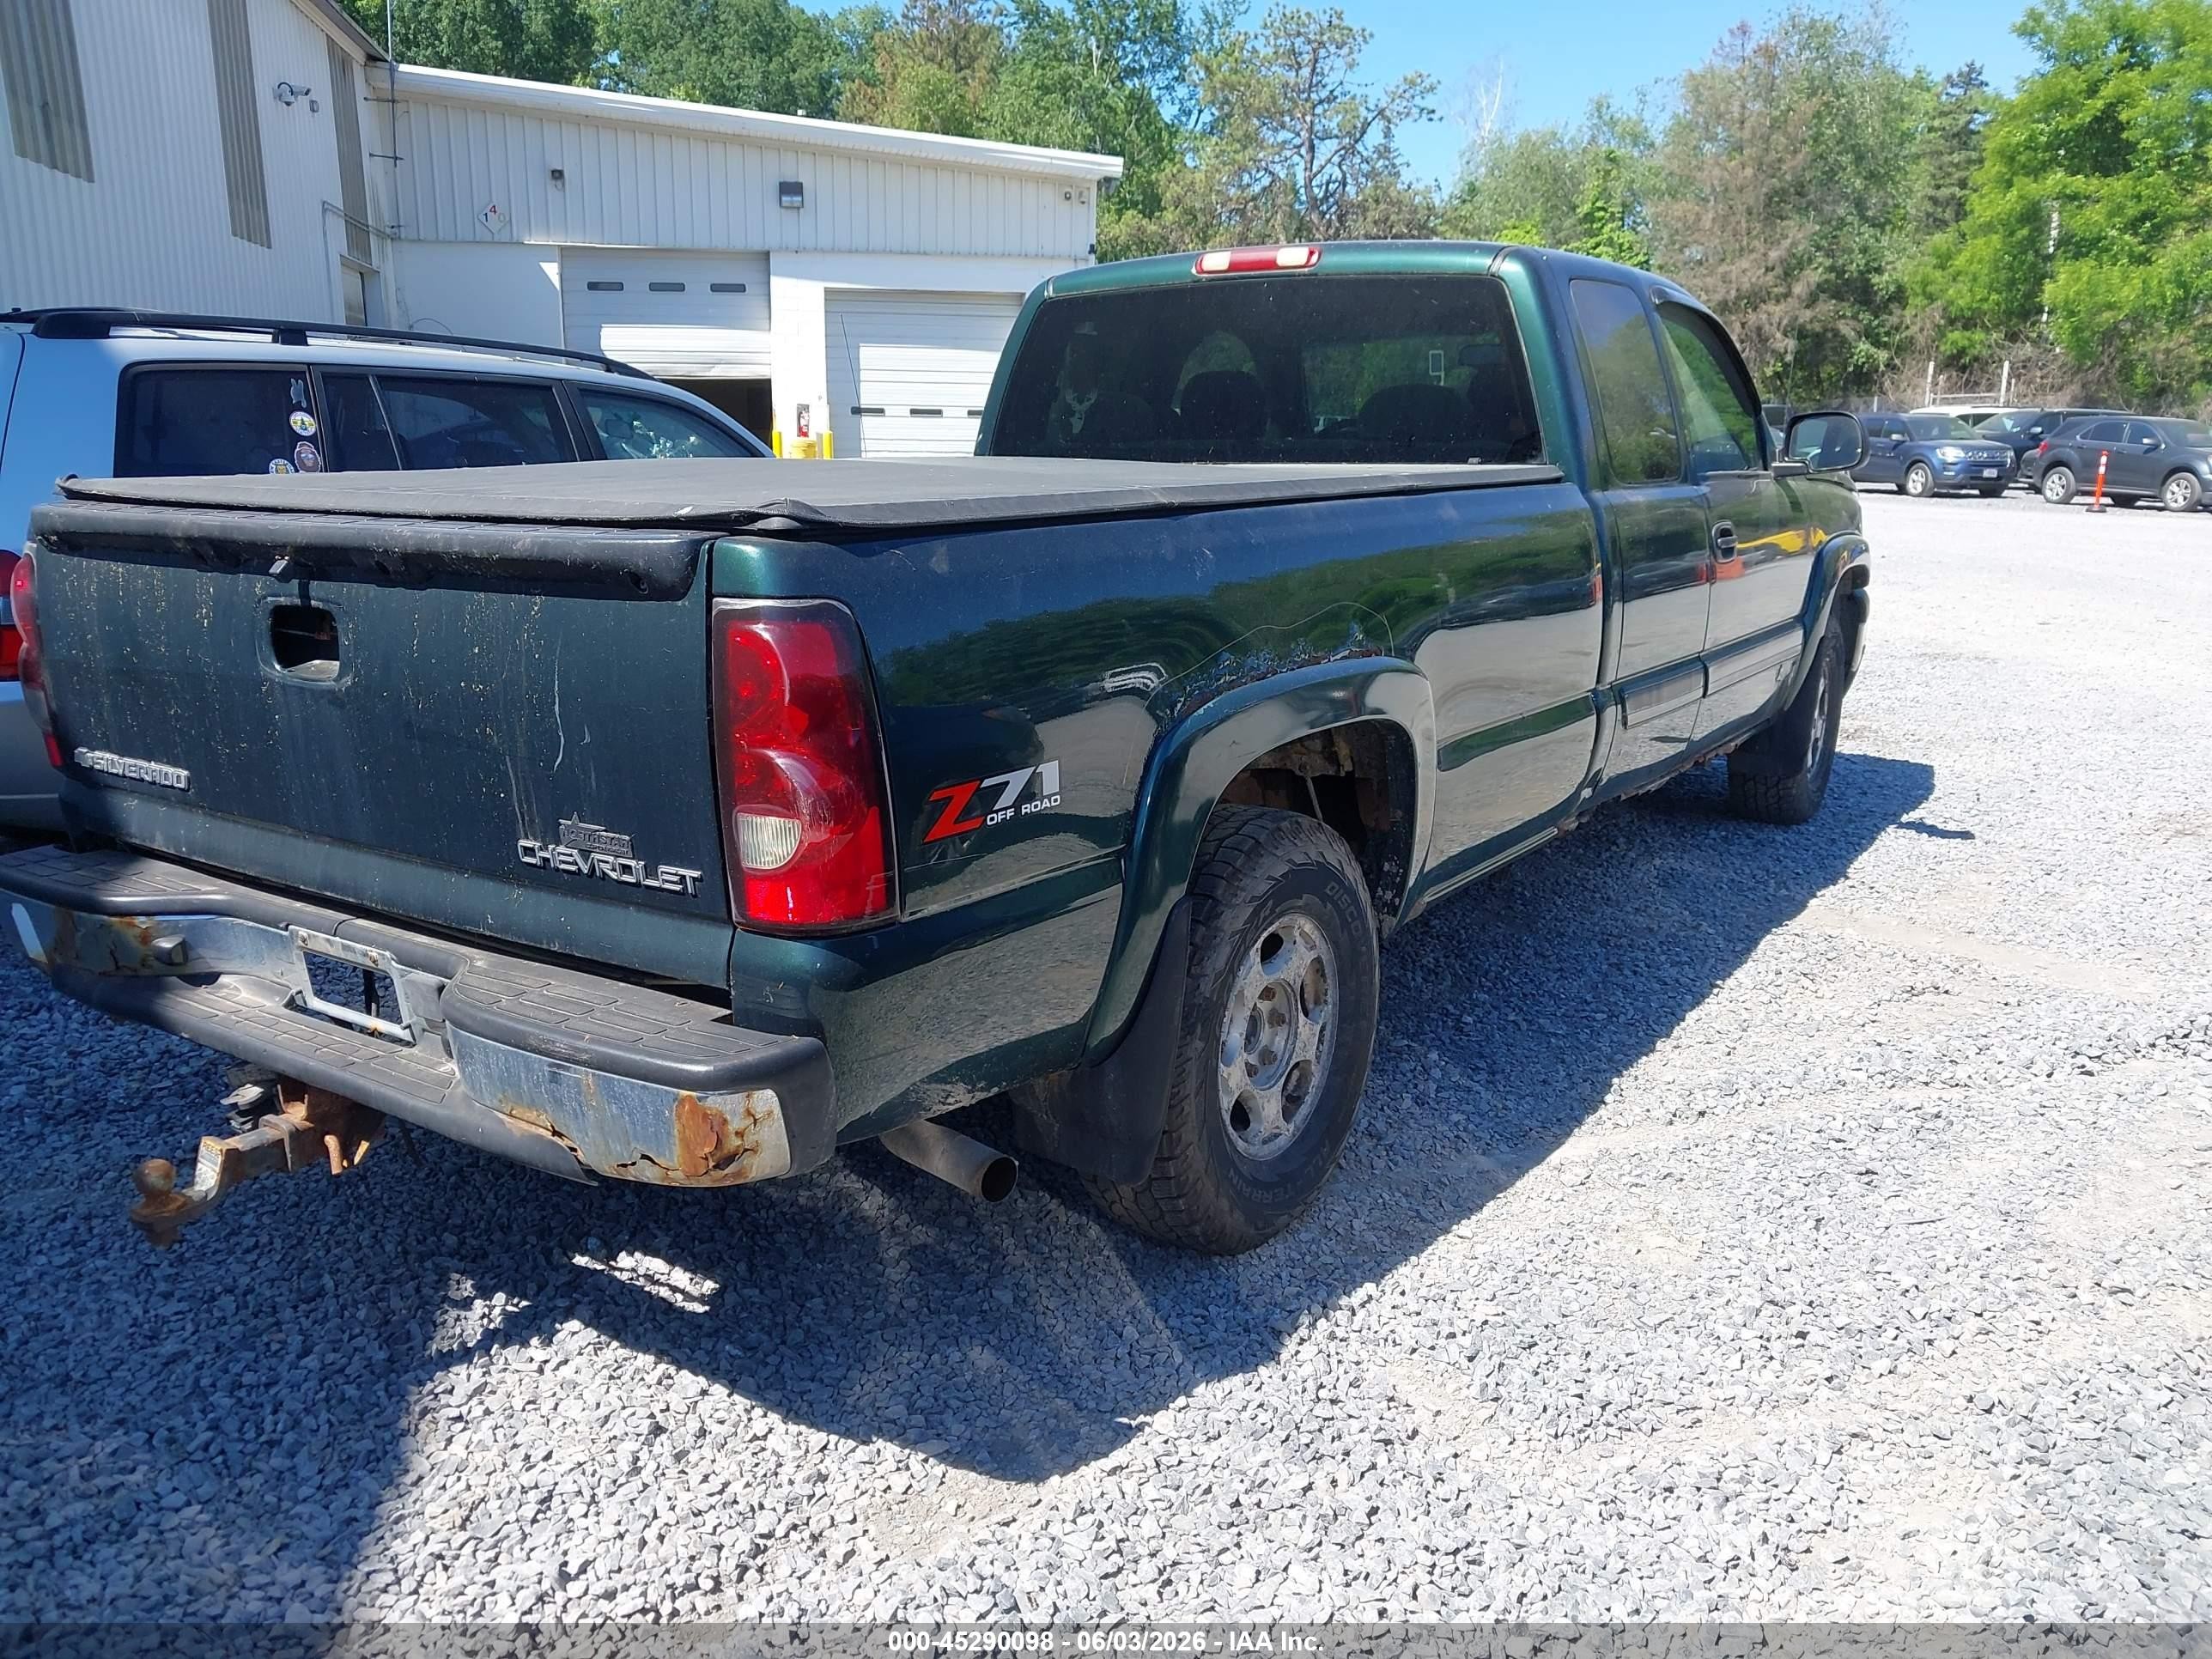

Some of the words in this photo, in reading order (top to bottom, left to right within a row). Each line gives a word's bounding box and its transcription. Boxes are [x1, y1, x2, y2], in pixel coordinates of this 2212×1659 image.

[483, 212, 488, 222] 1
[489, 204, 497, 215] 4
[93, 750, 191, 791] SILVERADO
[923, 760, 1060, 843] Z71
[987, 807, 1015, 826] OFF
[1021, 794, 1060, 816] ROAD
[517, 839, 702, 896] CHEVROLET
